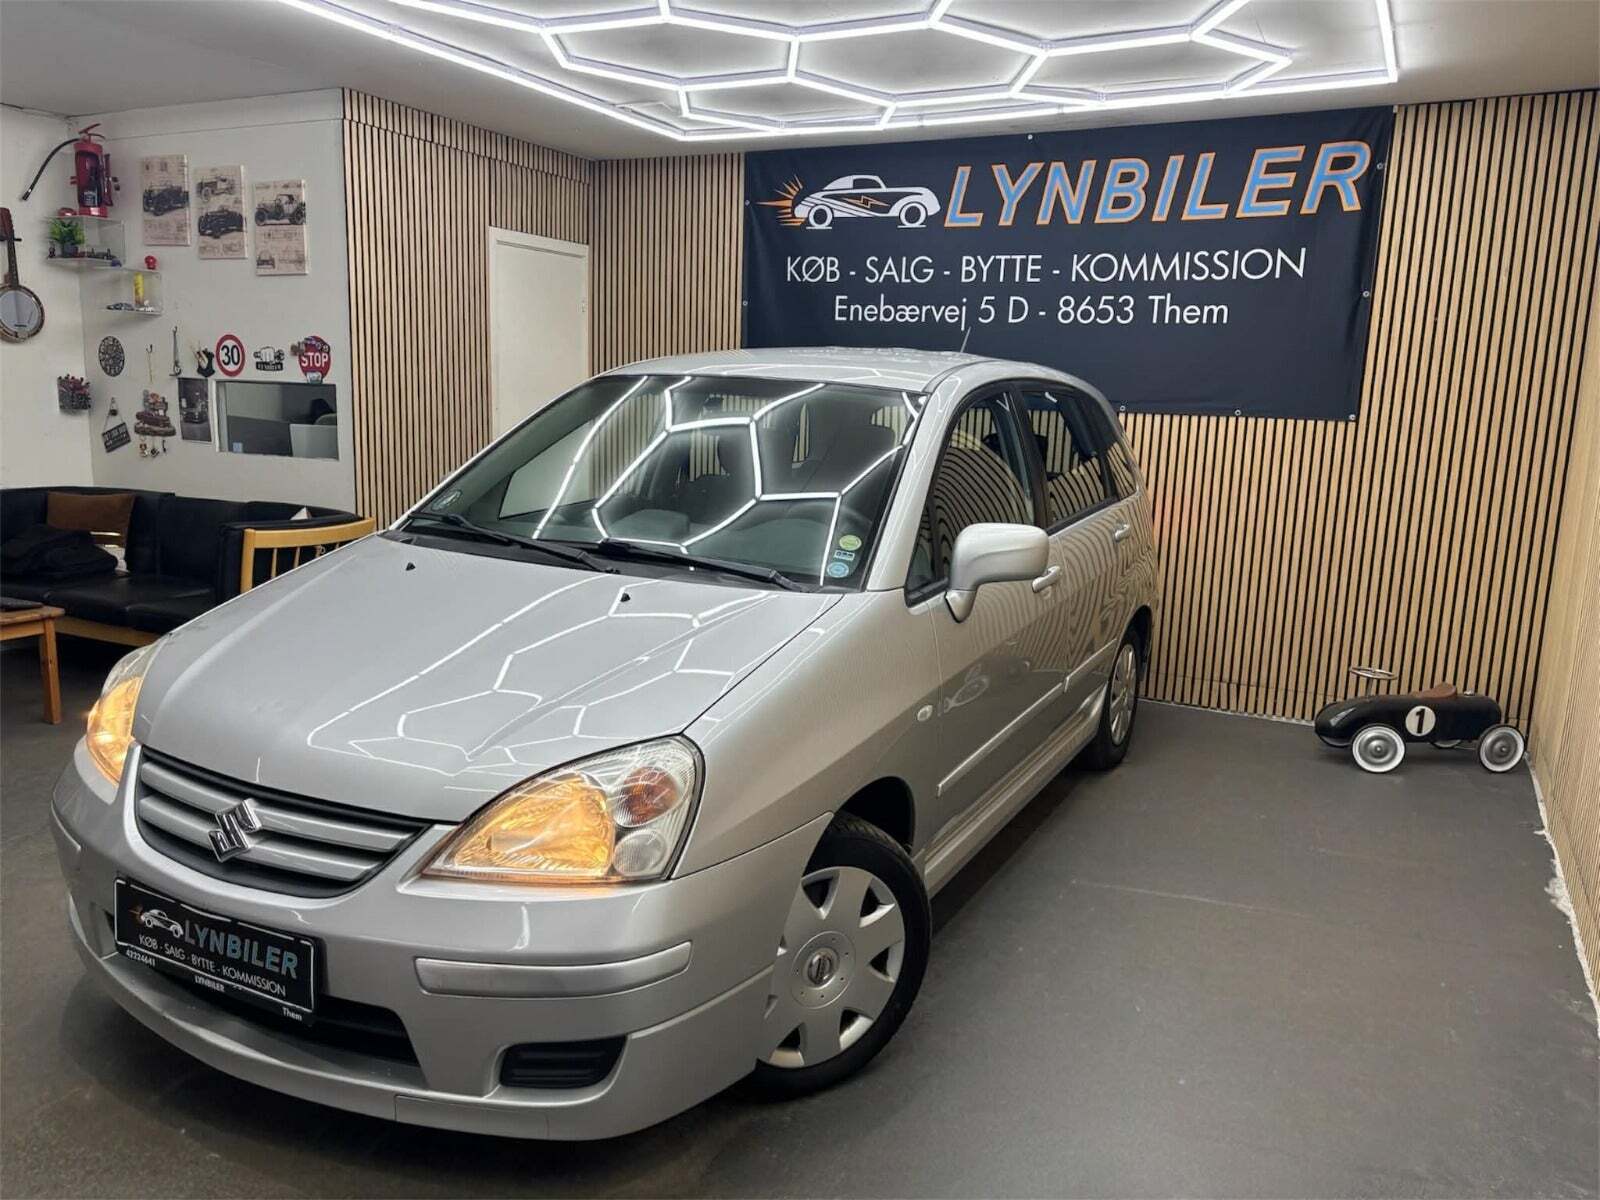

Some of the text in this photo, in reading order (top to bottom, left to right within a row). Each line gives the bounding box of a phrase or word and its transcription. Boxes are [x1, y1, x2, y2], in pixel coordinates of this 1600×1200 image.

[943, 138, 1372, 228] LYNBILER
[786, 256, 841, 283] KØB
[865, 256, 934, 283] SALG
[961, 254, 1043, 283] BYTTE
[1071, 247, 1307, 282] KOMMISSION
[834, 293, 967, 331] Enebærvej
[978, 295, 996, 324] 5
[1008, 296, 1029, 323] D
[1057, 295, 1135, 325] 8653
[1148, 292, 1230, 325] Them
[221, 345, 240, 366] 30
[301, 352, 329, 368] STOP
[1415, 708, 1425, 734] 1
[138, 934, 158, 950] KØB
[163, 943, 186, 961] SALG
[191, 953, 216, 974] BYTTE
[222, 965, 287, 997] KOMMISSION
[184, 920, 299, 980] LYNBILER
[283, 1007, 302, 1021] Them
